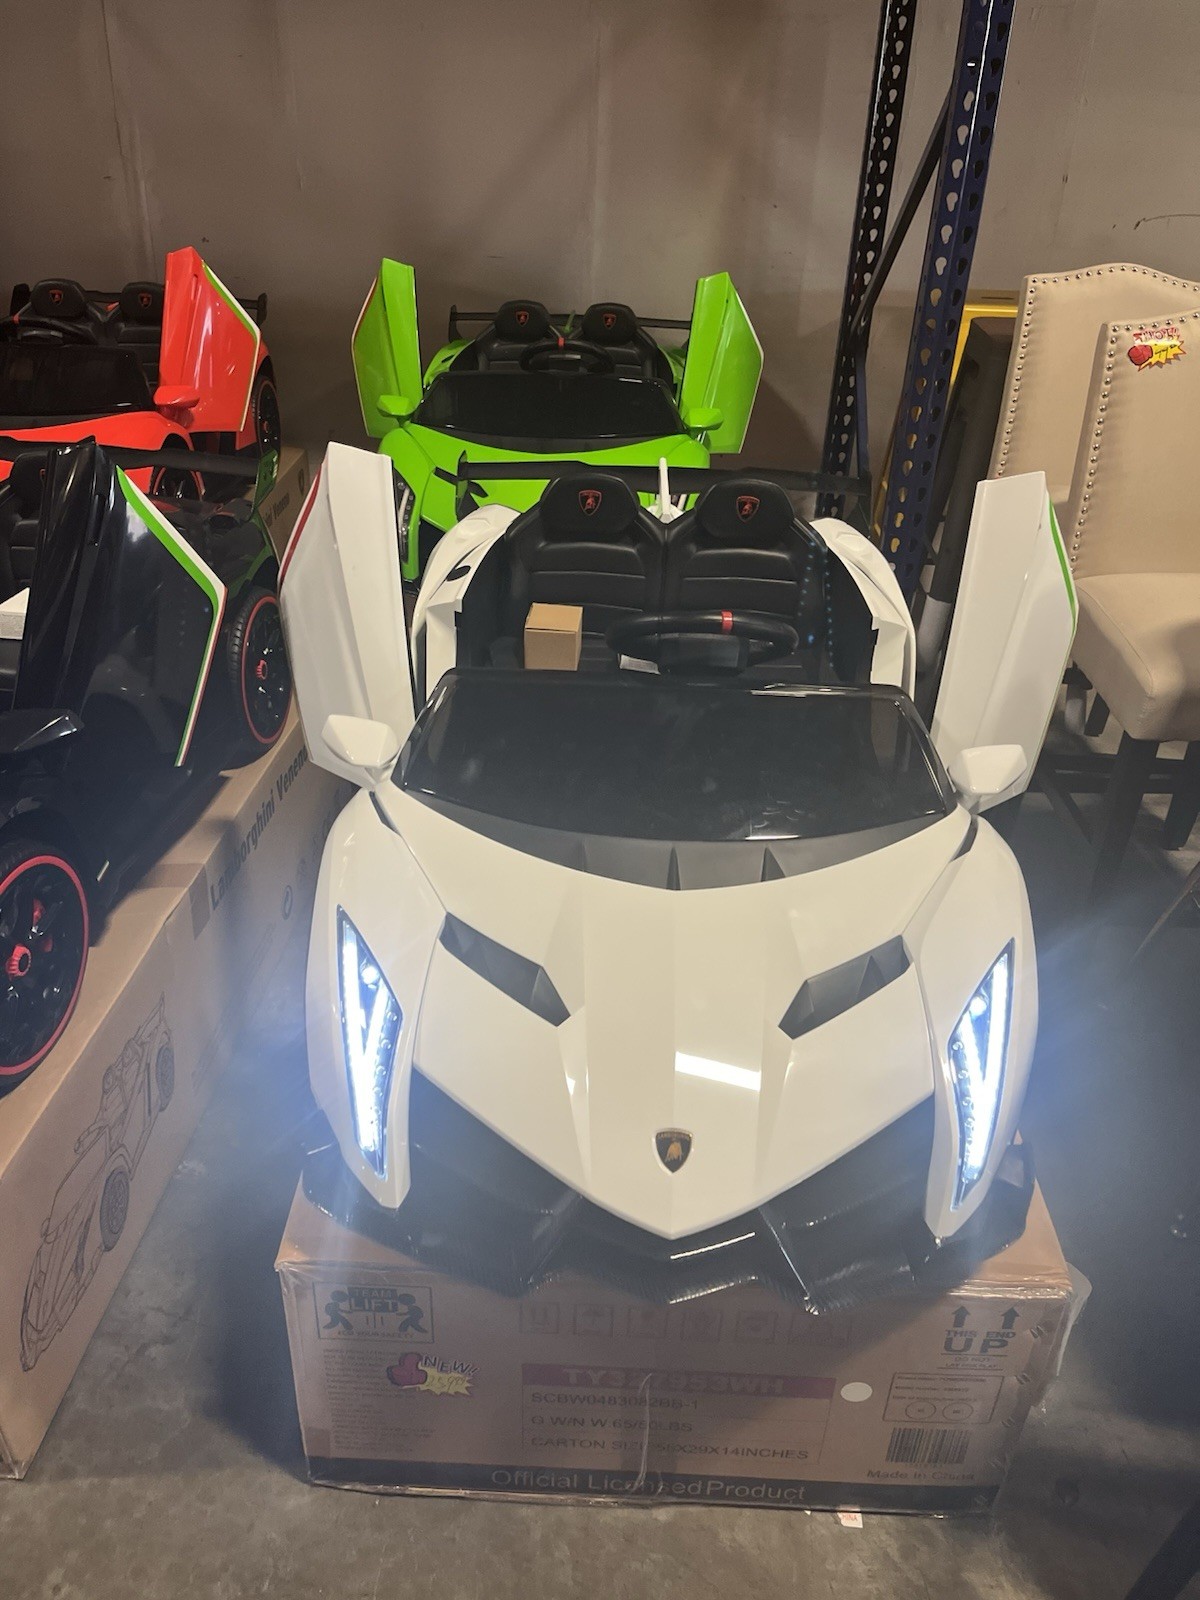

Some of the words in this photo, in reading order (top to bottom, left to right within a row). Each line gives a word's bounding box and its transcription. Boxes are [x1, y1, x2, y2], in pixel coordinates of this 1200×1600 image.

[210, 788, 275, 911] Lamborghini
[354, 1288, 394, 1299] TEAM
[350, 1298, 398, 1312] LIFT
[945, 1329, 977, 1338] THIS
[986, 1331, 1016, 1339] END
[944, 1338, 1009, 1354] UP
[531, 1437, 606, 1450] CARTON
[866, 1469, 907, 1480] Made
[491, 1469, 578, 1489] Official
[706, 1480, 806, 1501] Product
